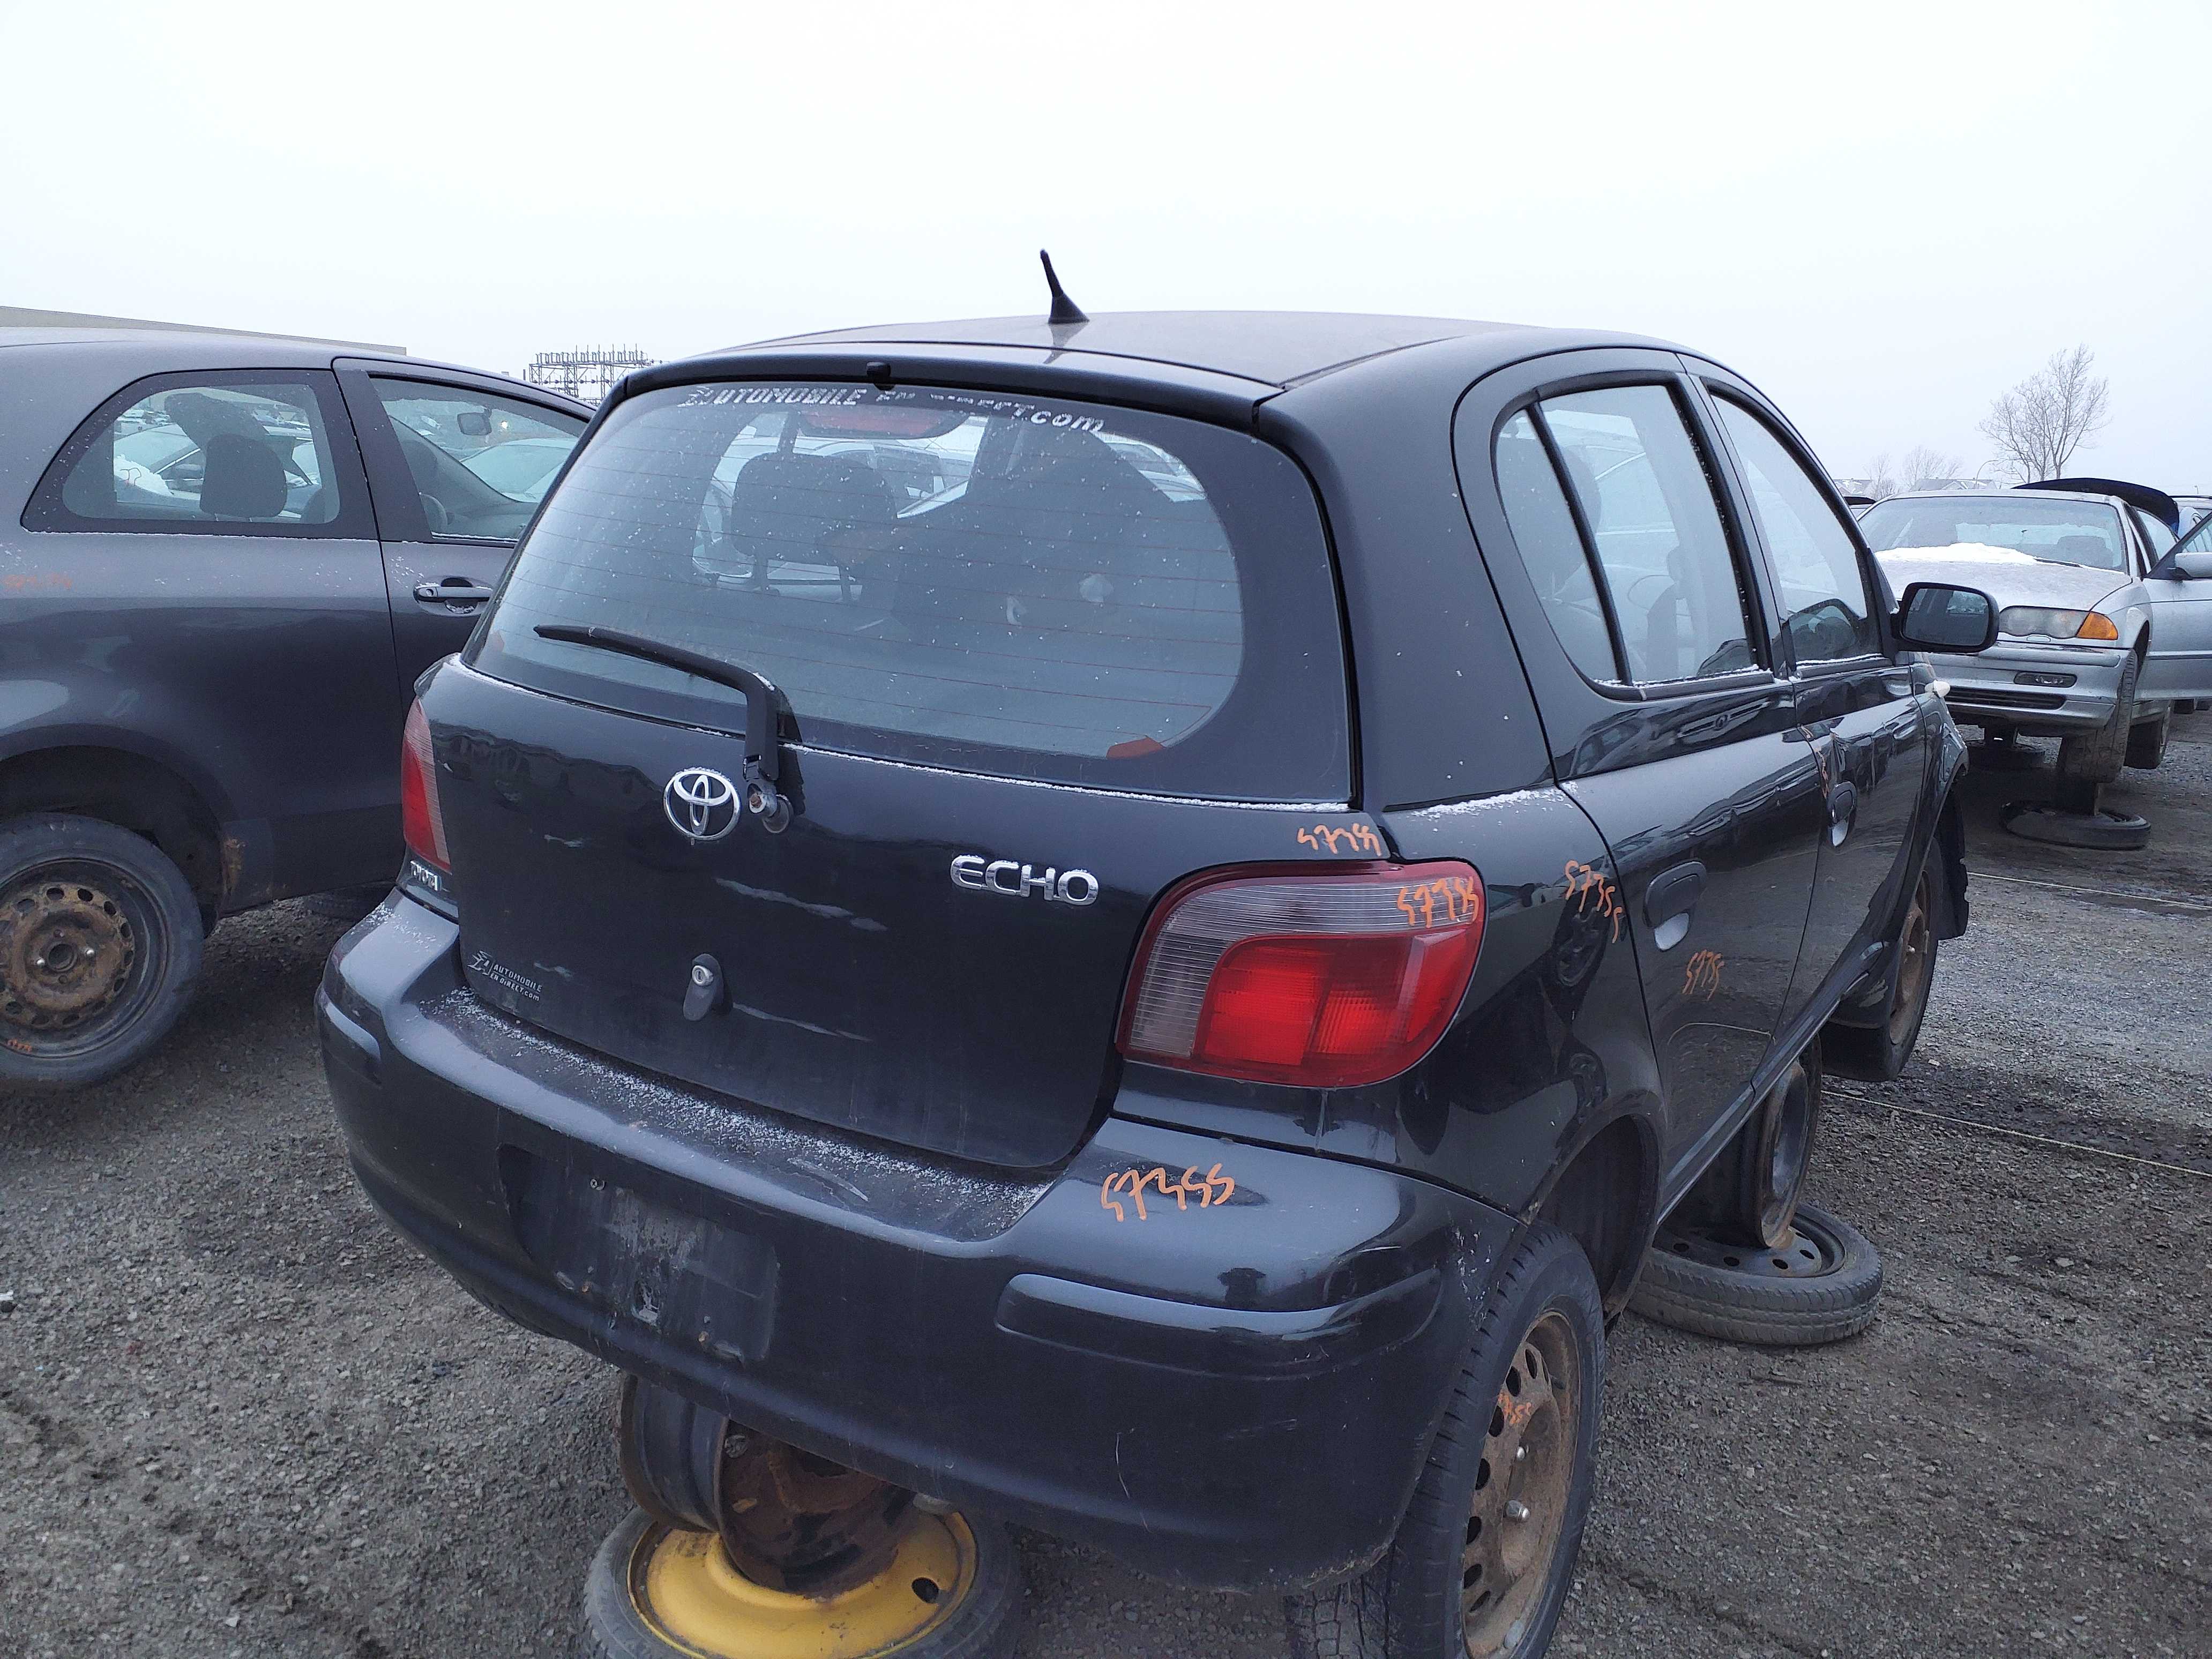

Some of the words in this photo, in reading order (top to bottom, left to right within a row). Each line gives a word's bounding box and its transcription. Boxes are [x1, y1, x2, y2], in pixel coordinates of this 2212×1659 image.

[950, 855, 1098, 906] ECHO
[490, 973, 499, 981] EN
[493, 964, 543, 992] AUTOMOBILE
